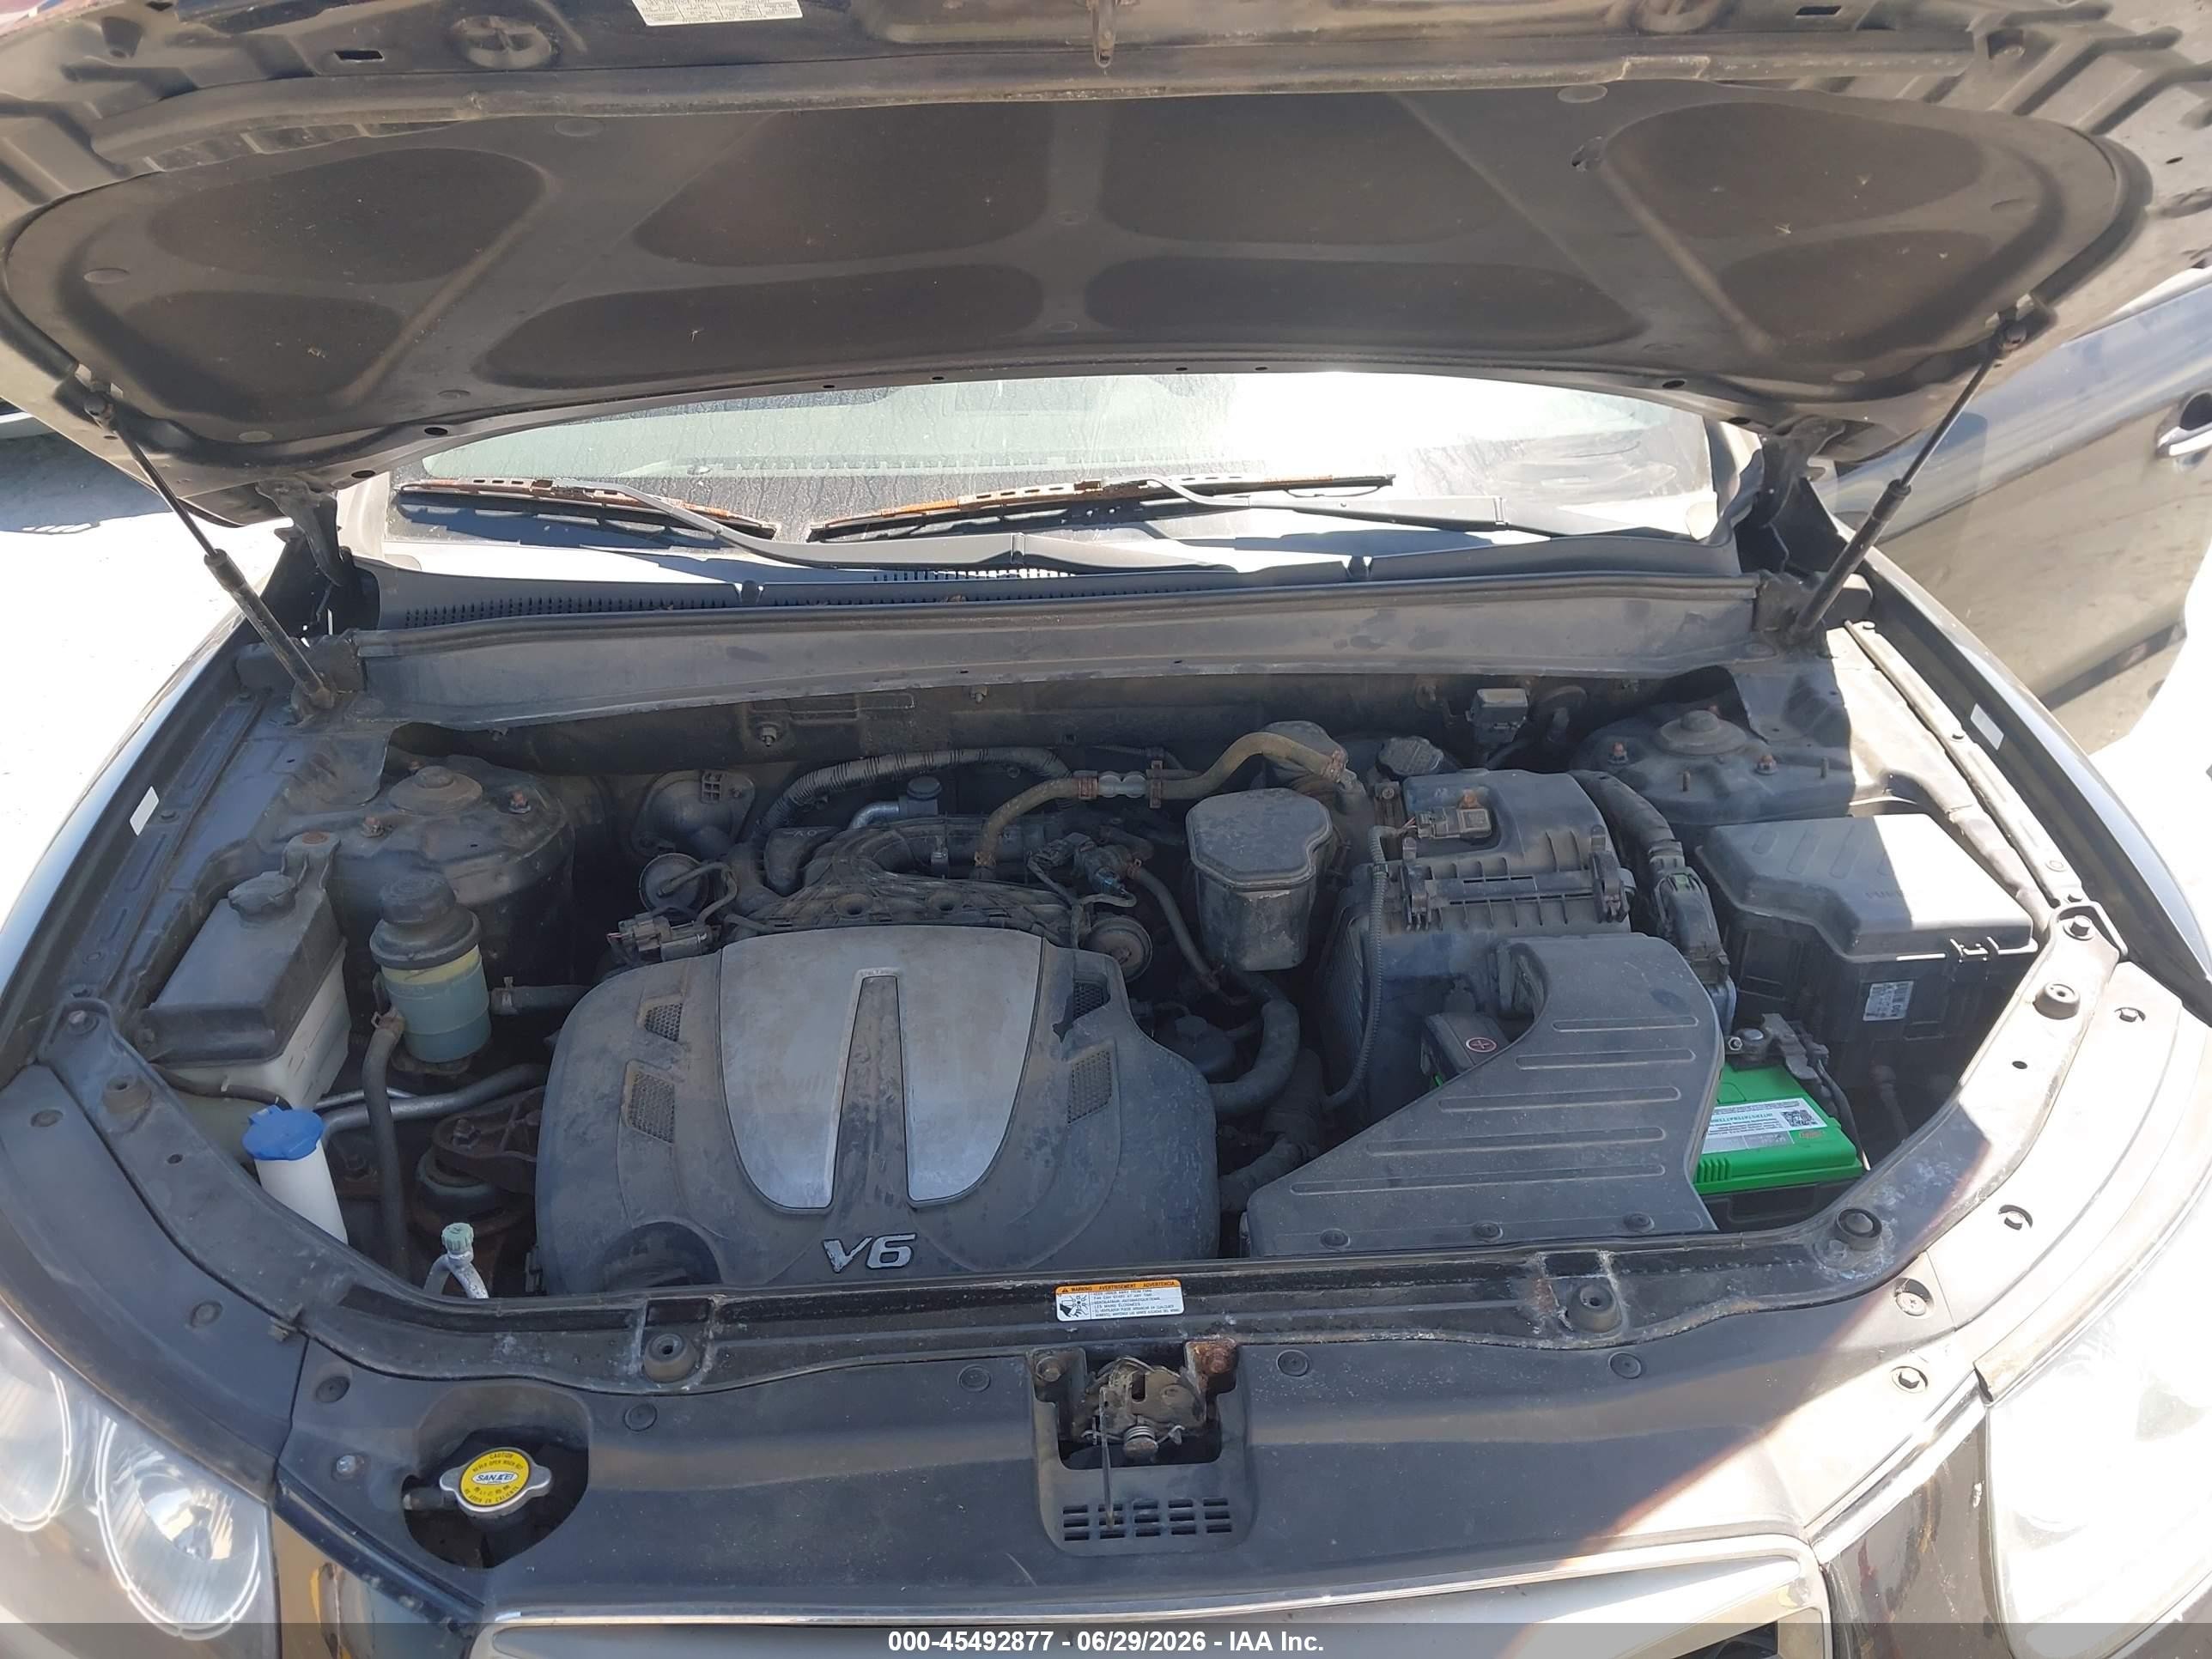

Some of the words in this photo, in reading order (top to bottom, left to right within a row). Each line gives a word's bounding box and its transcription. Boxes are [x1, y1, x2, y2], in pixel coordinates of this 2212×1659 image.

[822, 1233, 917, 1273] V6
[472, 1462, 488, 1473] NEVER
[476, 1474, 514, 1482] SANKEI
